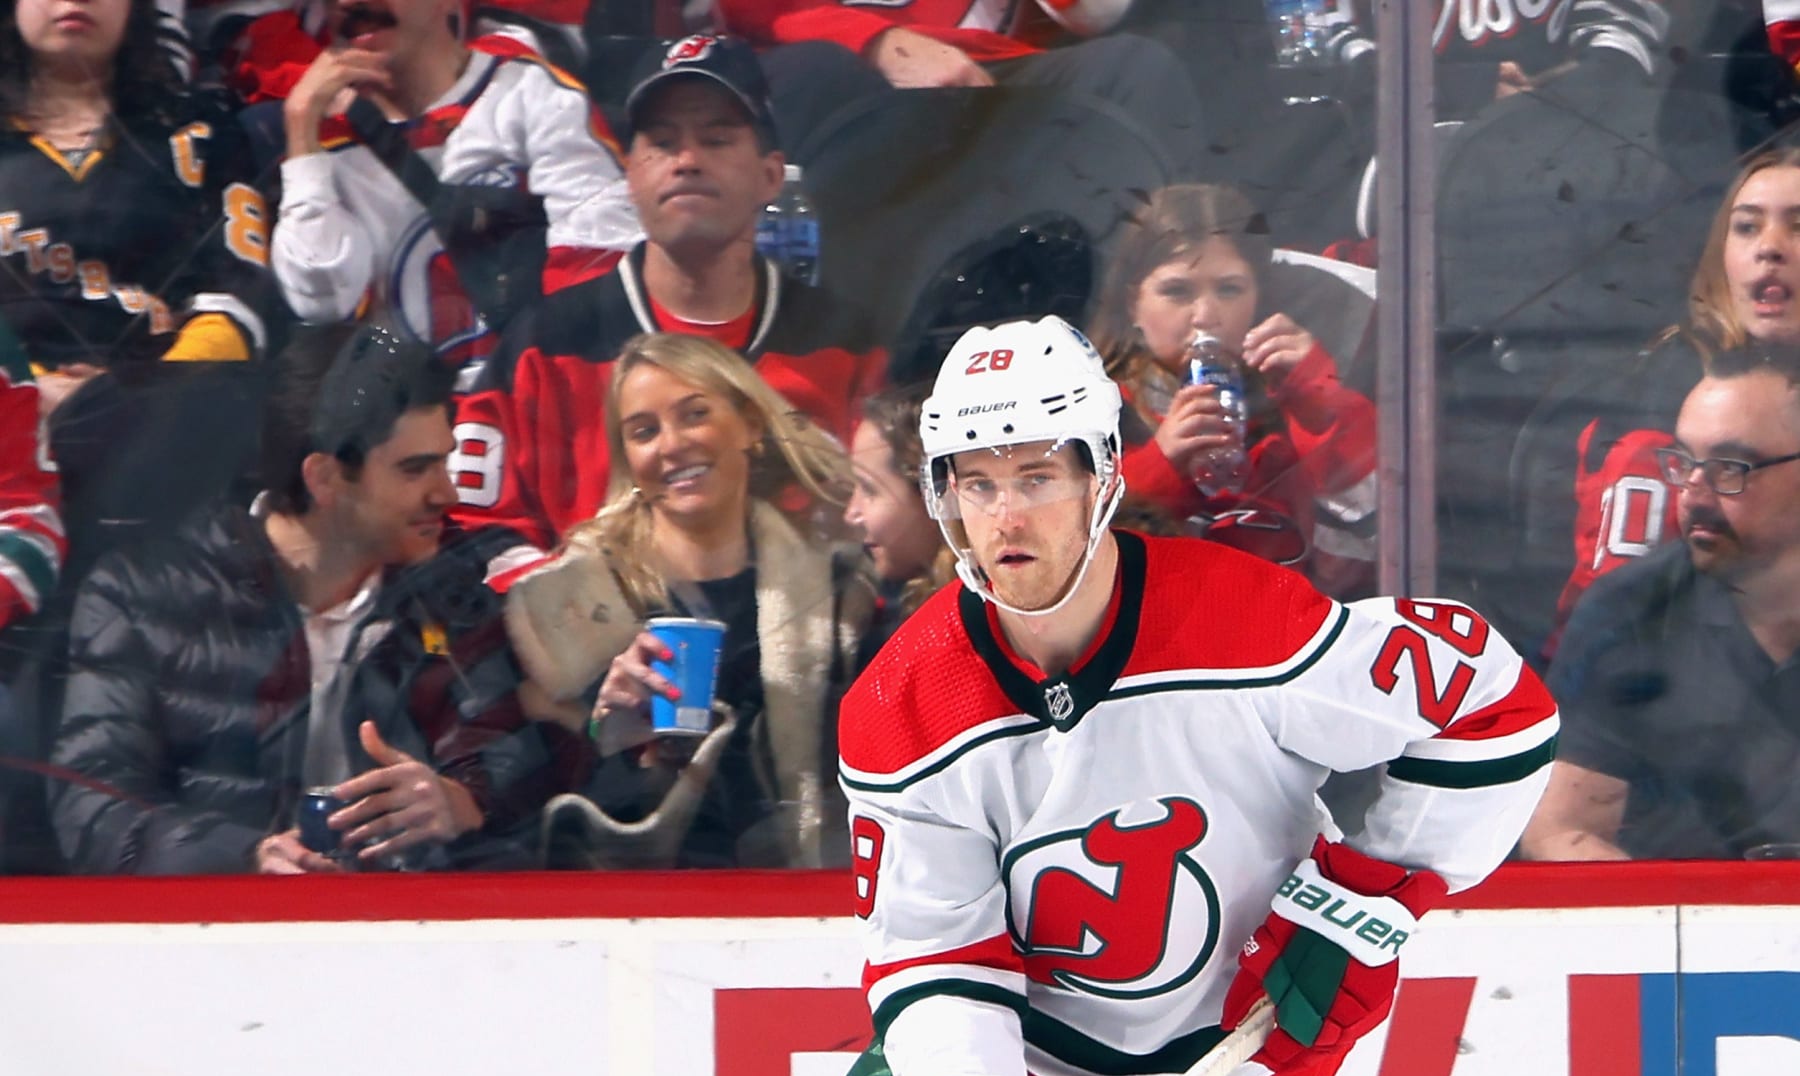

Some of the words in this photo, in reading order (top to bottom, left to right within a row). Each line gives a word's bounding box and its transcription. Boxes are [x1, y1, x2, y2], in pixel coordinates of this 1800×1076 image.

[965, 349, 1014, 376] 28
[957, 400, 1017, 417] BAUER
[446, 422, 504, 508] 8
[1369, 597, 1490, 731] 28
[1276, 873, 1410, 956] BAUER
